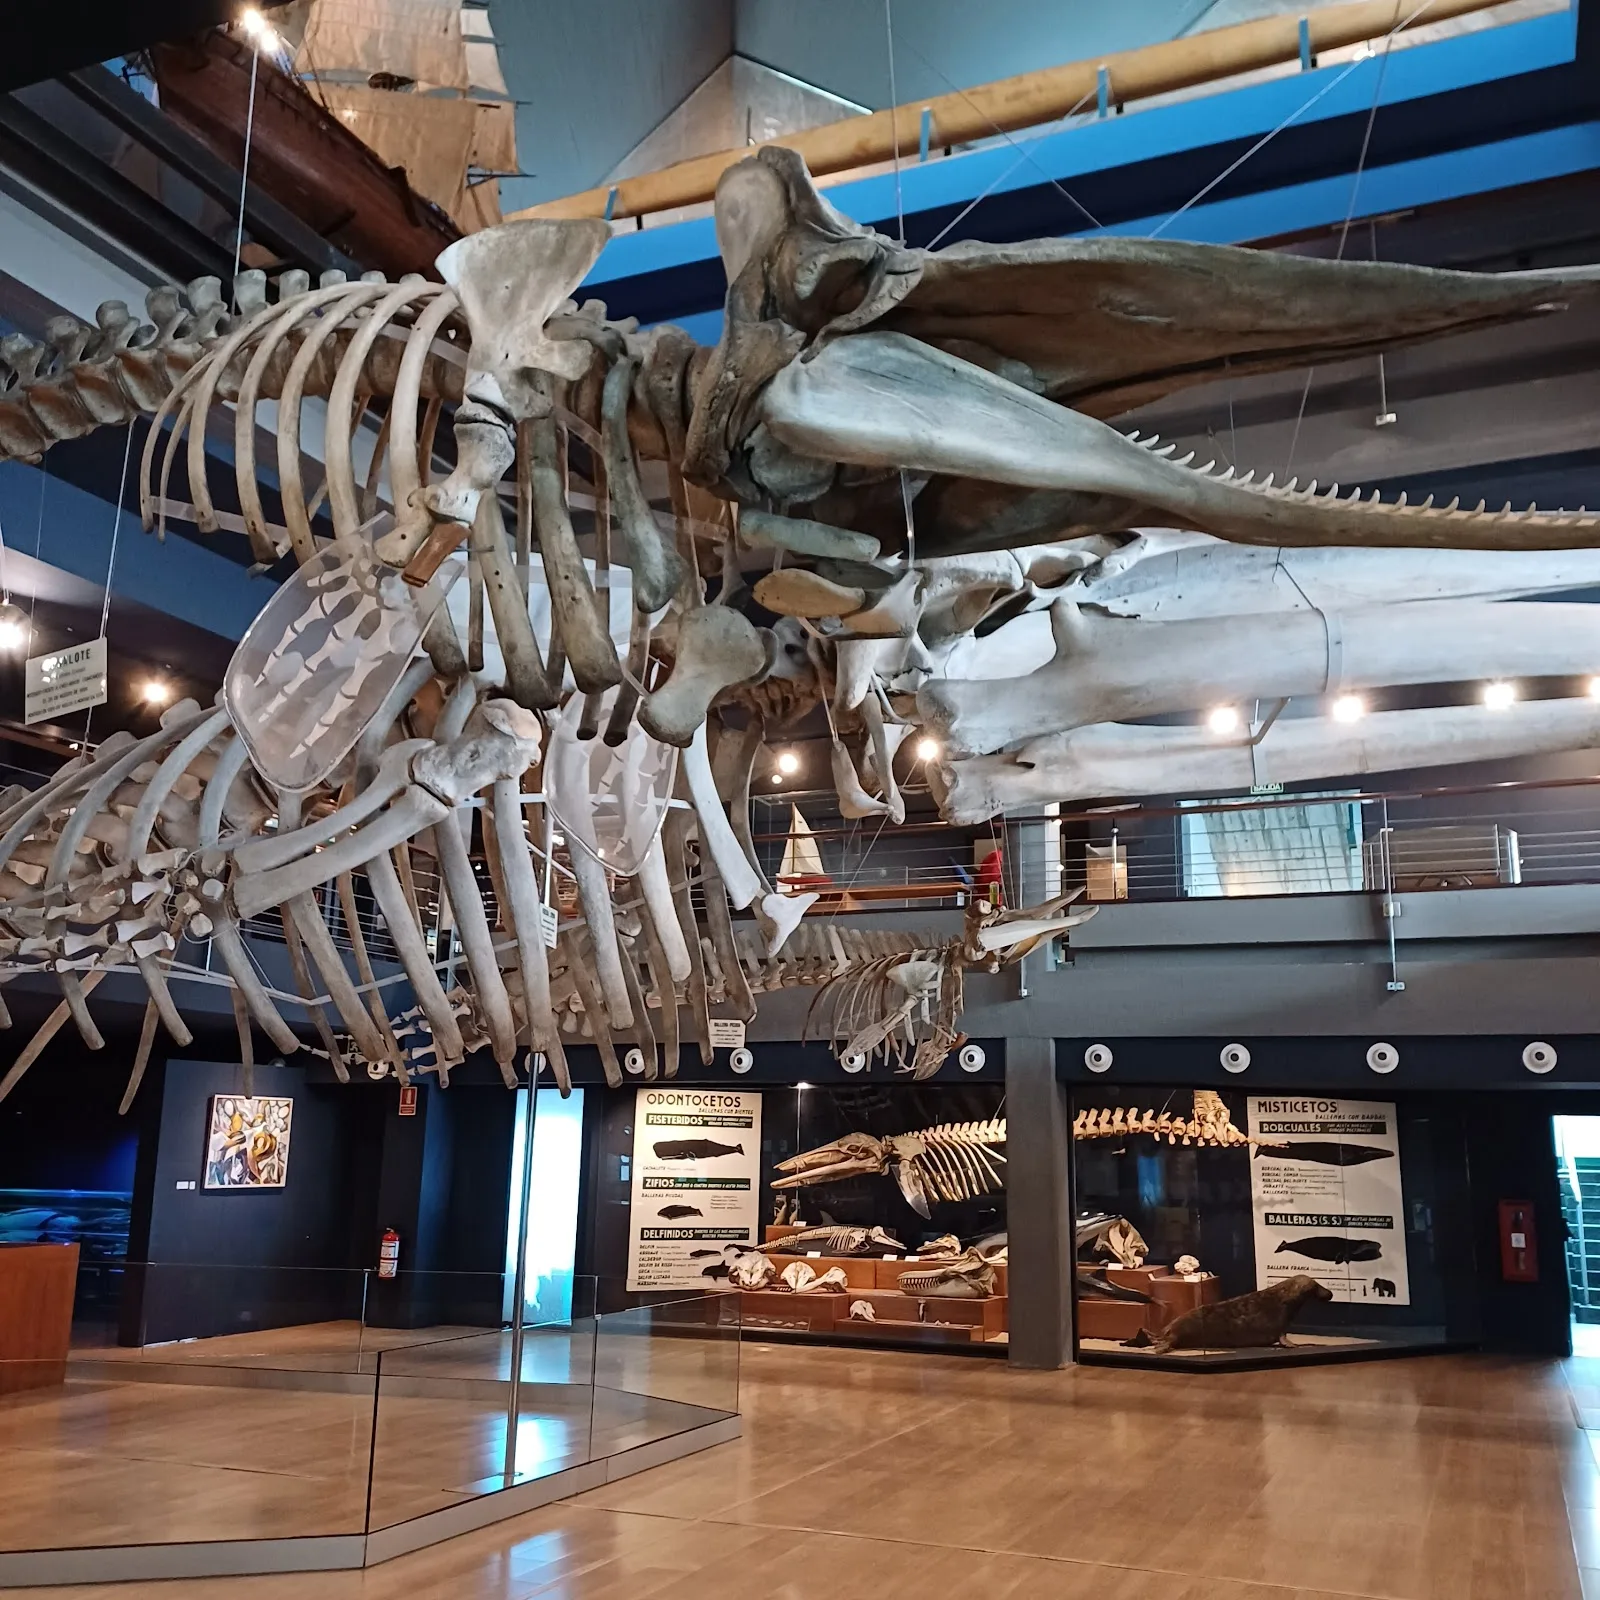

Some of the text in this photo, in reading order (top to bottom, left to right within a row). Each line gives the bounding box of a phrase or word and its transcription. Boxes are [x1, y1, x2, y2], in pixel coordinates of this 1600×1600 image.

[646, 1094, 741, 1108] ODONTOCETOS
[1258, 1101, 1338, 1113] MISTICETOS
[648, 1114, 703, 1125] FISETERIDOS
[1263, 1123, 1321, 1132] RORCUALES
[645, 1178, 675, 1188] ZIFIOS
[1268, 1214, 1318, 1225] BALLENAS
[644, 1229, 694, 1239] DELFINIDOS
